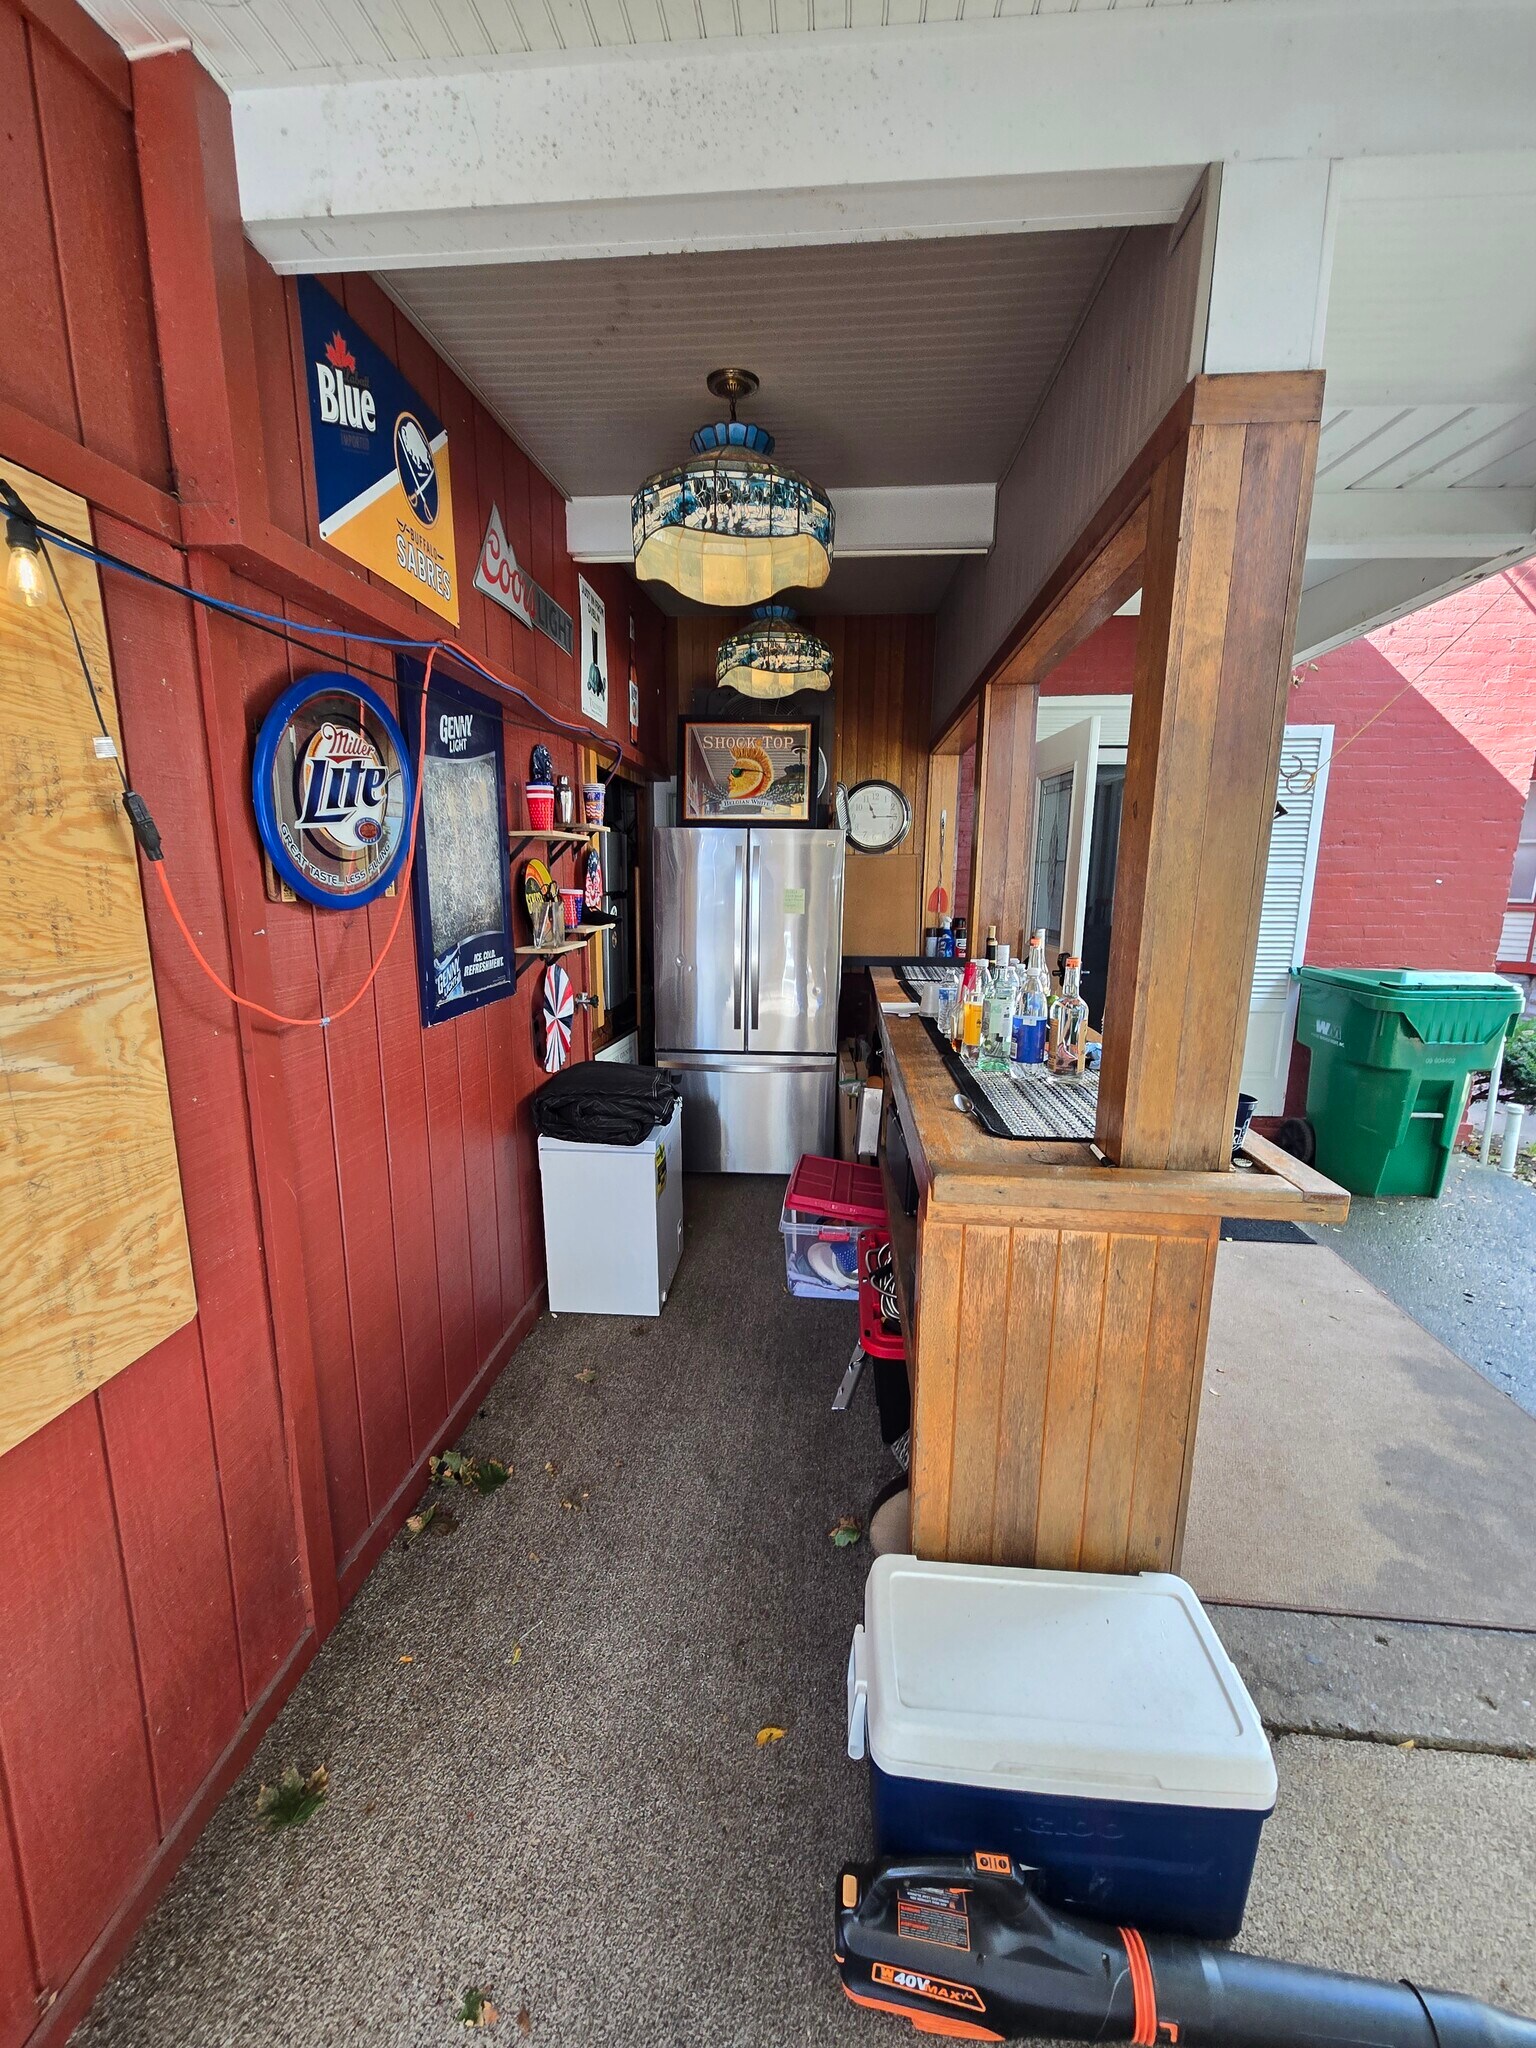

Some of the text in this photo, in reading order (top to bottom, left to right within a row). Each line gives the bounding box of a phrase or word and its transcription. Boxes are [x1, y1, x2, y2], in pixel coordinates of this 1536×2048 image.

[315, 362, 376, 432] Blue
[410, 527, 438, 560] BUFFALO
[396, 533, 451, 602] SABRES
[481, 528, 572, 652] Coors LIGHT
[322, 723, 375, 756] Miller
[440, 714, 473, 745] GENNY
[703, 736, 794, 749] SHOCK TOP
[449, 738, 467, 754] LIGHT
[298, 758, 387, 825] Lite
[724, 799, 751, 807] BELGIAN
[872, 792, 880, 801] 12
[890, 803, 896, 811] 2
[280, 822, 309, 869] GREAT
[345, 870, 366, 886] LESS
[366, 841, 391, 875] FILLING
[473, 952, 483, 963] ICE
[436, 957, 460, 995] GENNY
[1316, 1019, 1341, 1040] WM
[894, 1972, 930, 1991] 40V
[925, 1984, 960, 2001] MAX
